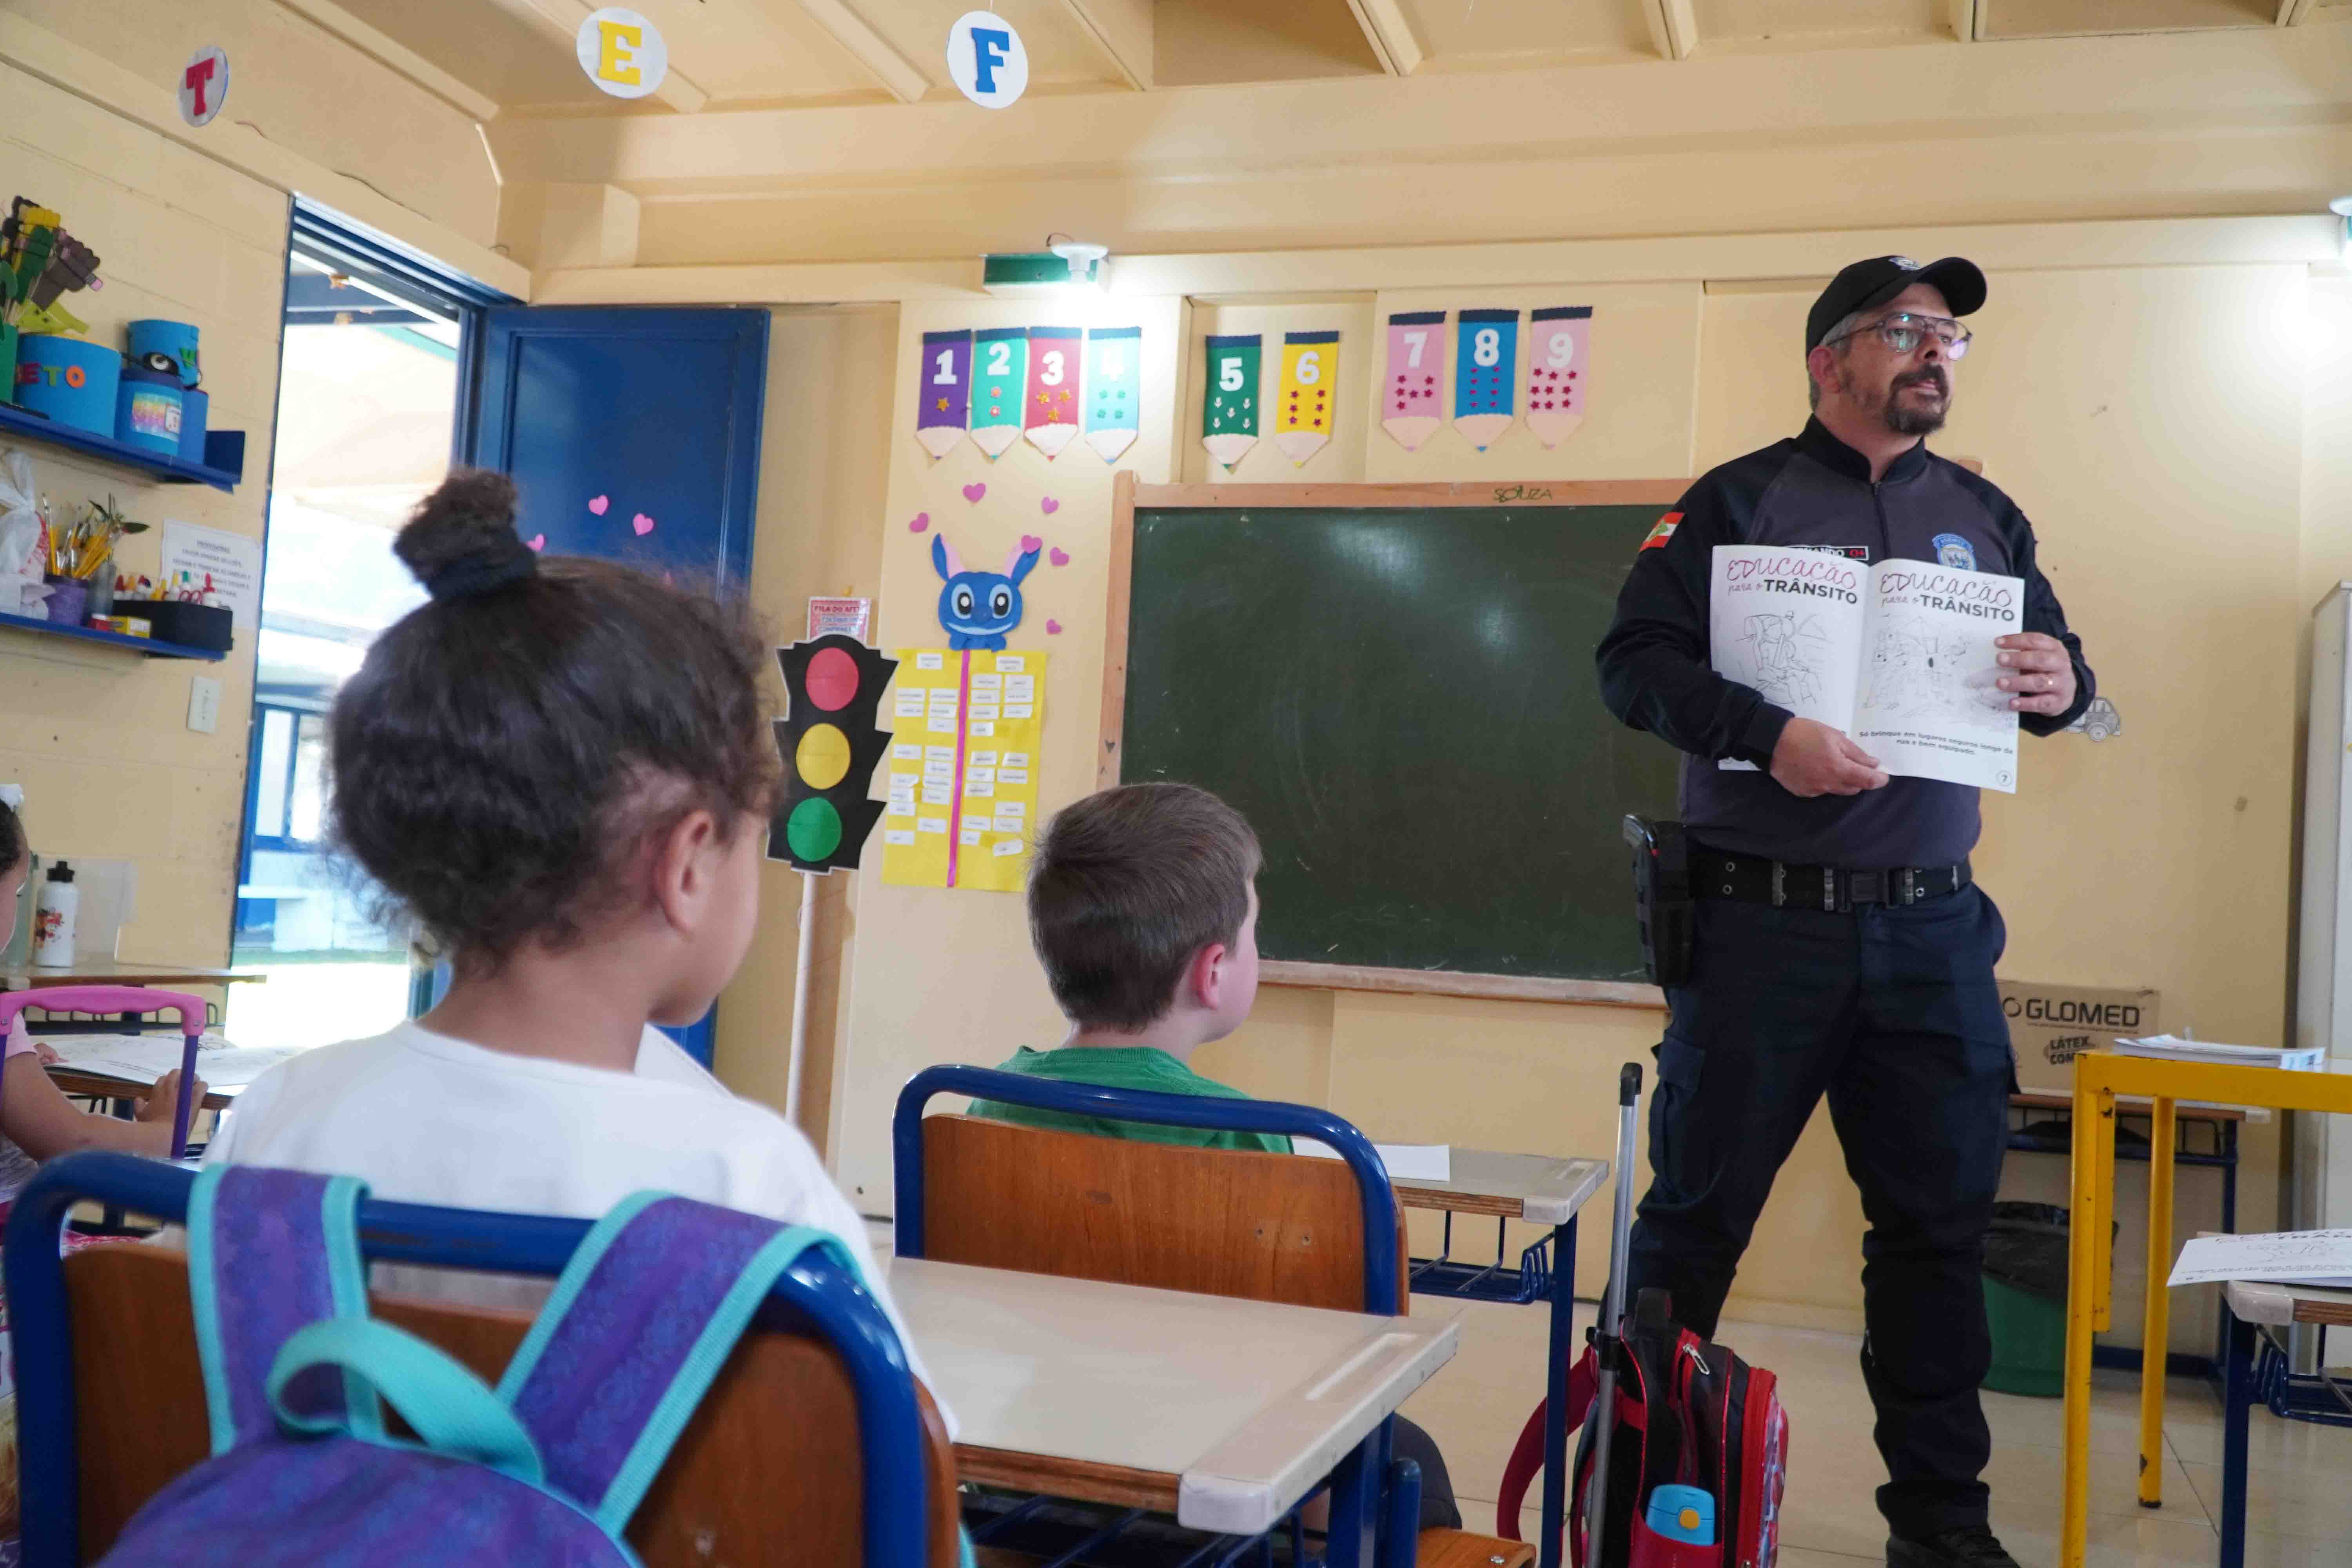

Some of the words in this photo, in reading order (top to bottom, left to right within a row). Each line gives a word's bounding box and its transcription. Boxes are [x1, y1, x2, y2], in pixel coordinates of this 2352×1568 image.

[599, 21, 642, 86] E
[971, 27, 1010, 93] F
[186, 57, 215, 116] T
[933, 349, 958, 385] 1
[987, 342, 1010, 376] 2
[1041, 350, 1064, 386] 3
[1219, 358, 1244, 392] 5
[1296, 351, 1319, 385] 6
[1403, 332, 1428, 368] 7
[1474, 328, 1500, 367] 8
[1546, 332, 1573, 368] 9
[1764, 578, 1857, 604] TRÂNSITO
[1920, 595, 2015, 621] TRÂNSITO
[2026, 998, 2140, 1027] GLOMED
[2050, 1035, 2090, 1050] LÁTEX
